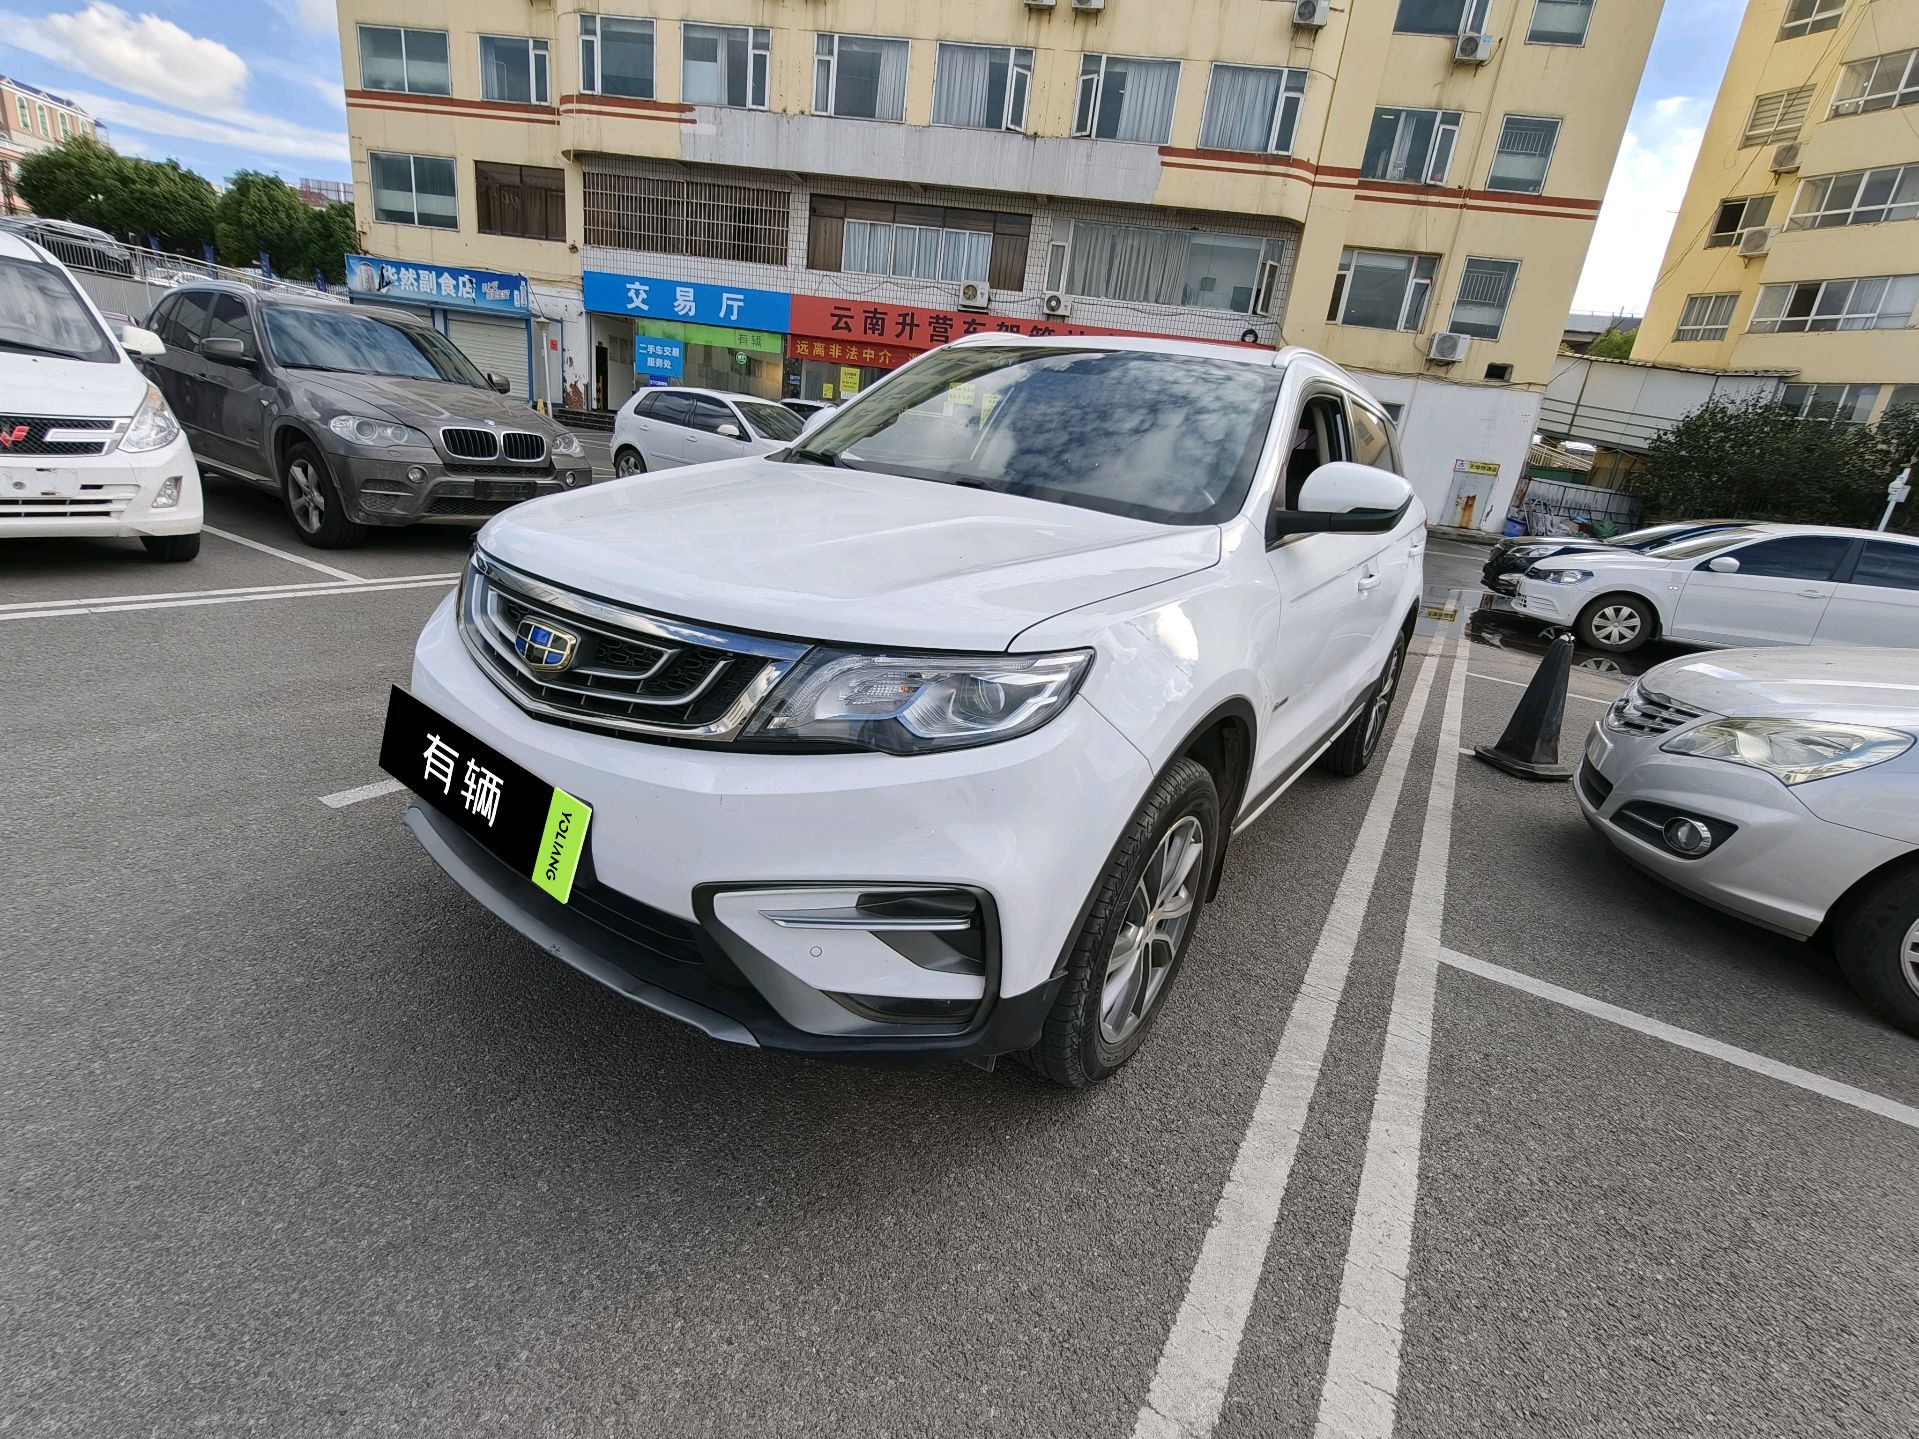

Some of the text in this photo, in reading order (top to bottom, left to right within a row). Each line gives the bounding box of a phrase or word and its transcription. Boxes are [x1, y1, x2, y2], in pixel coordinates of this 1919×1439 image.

[626, 281, 745, 321] 交易厅
[639, 343, 680, 357] 二手车交易
[646, 357, 672, 369] 服务处
